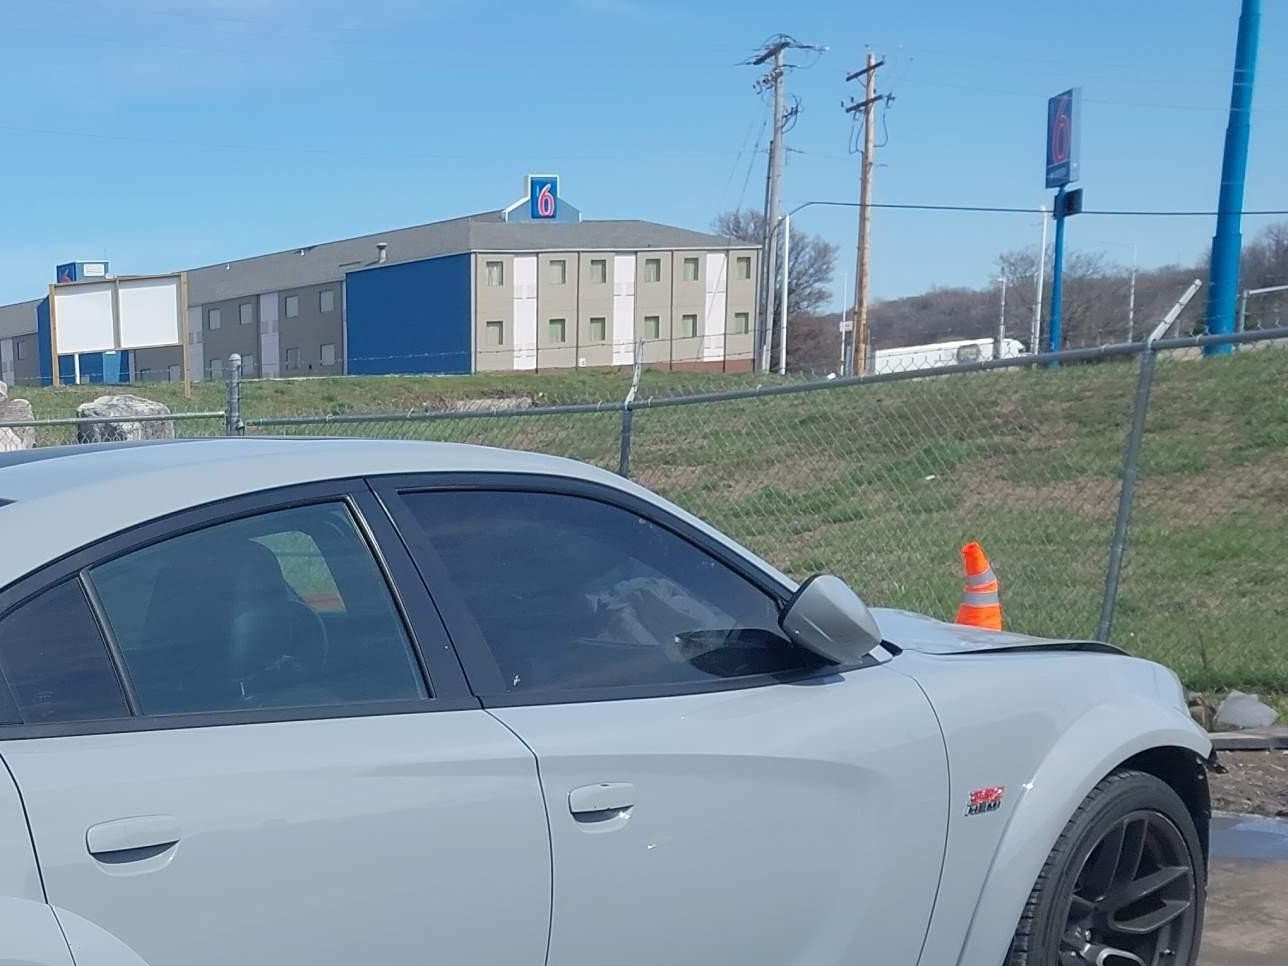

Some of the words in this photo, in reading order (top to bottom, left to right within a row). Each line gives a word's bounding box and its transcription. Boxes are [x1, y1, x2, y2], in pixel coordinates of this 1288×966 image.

[1053, 95, 1070, 164] 6
[538, 183, 555, 217] 6
[964, 800, 1001, 817] HEMI
